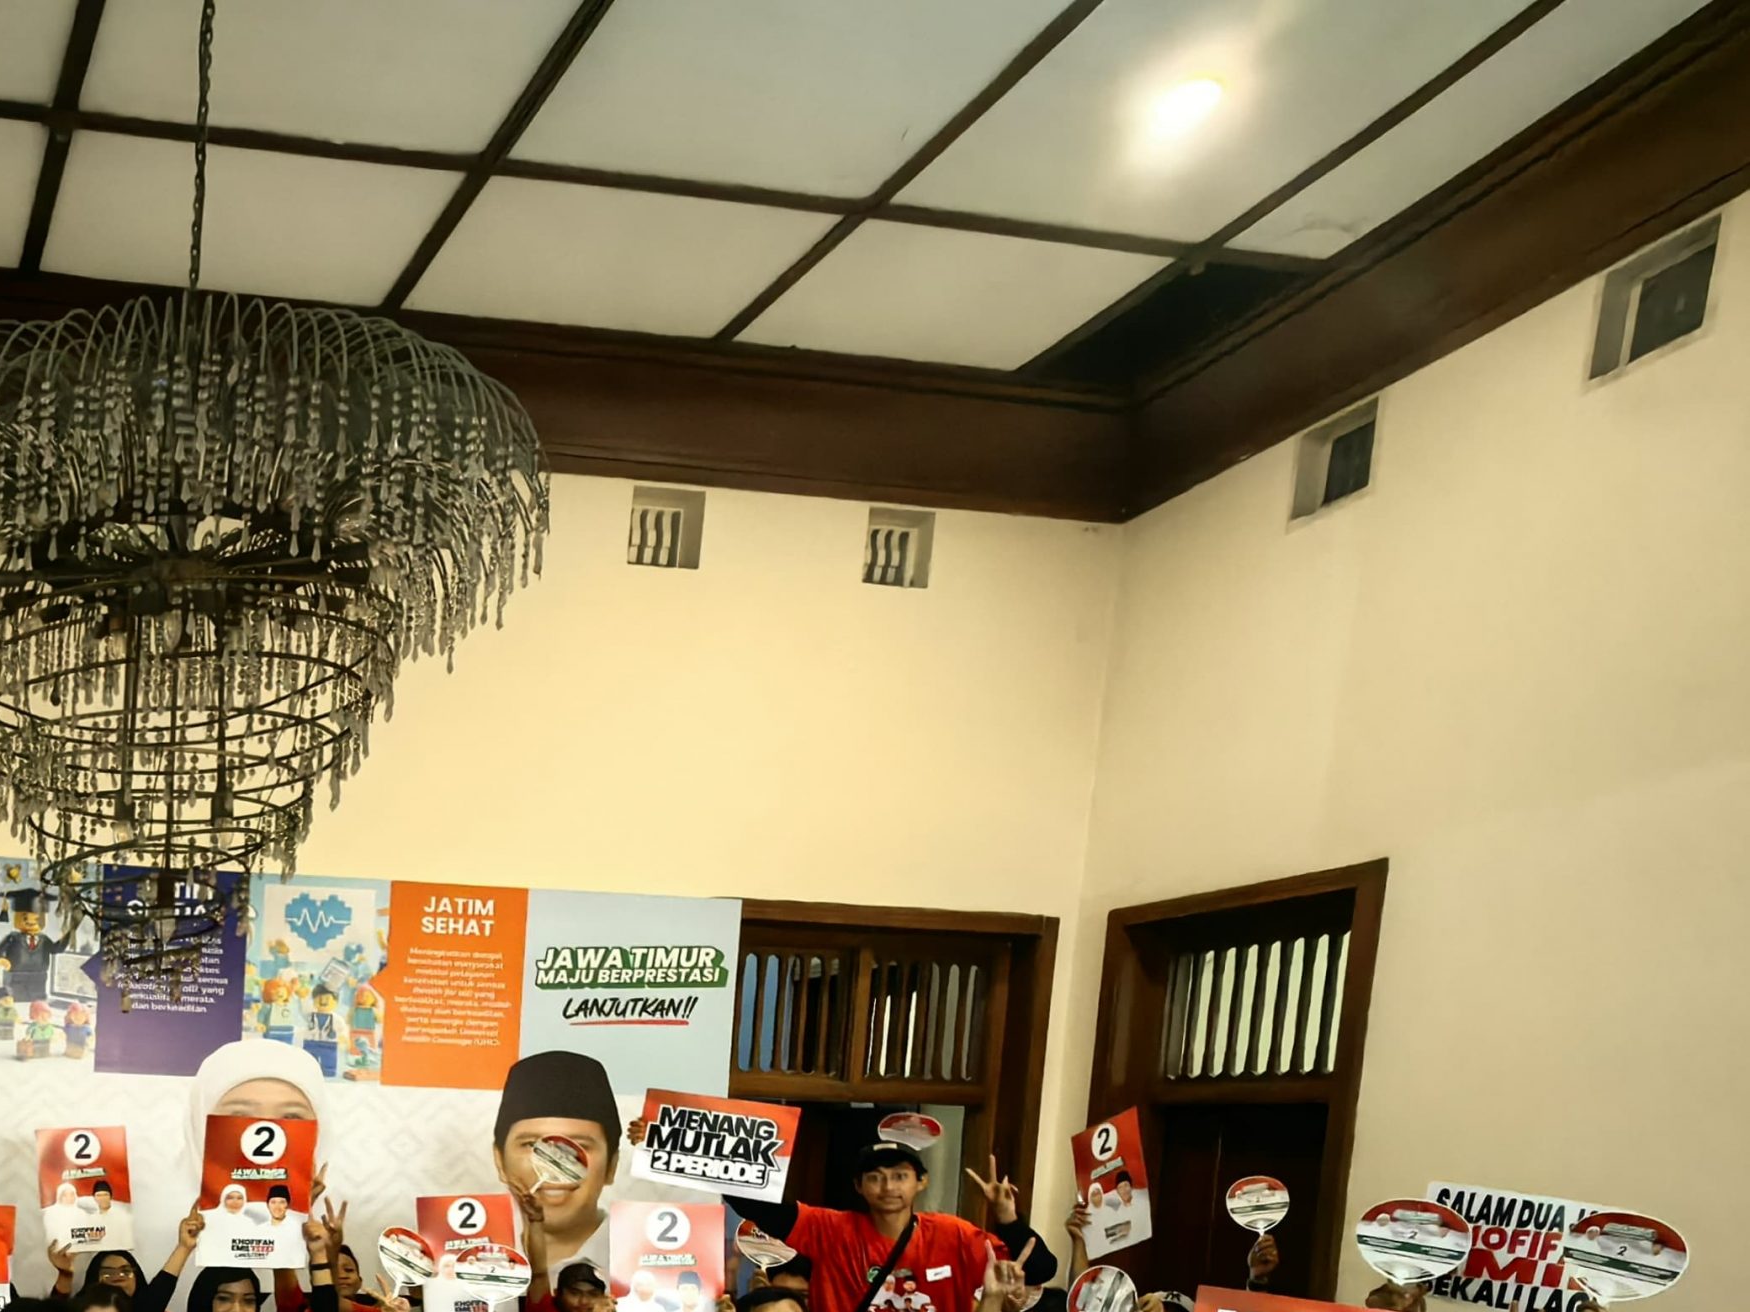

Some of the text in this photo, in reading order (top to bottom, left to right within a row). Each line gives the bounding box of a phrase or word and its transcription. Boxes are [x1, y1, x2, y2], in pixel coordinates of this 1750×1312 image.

[424, 896, 494, 916] JATIM
[421, 916, 494, 937] SEHAT
[536, 947, 716, 969] JAWA TIMUR
[536, 967, 720, 984] MAJU BERPRESTASI
[562, 996, 699, 1020] LANJUTKAN!!
[659, 1107, 775, 1141] MENANG
[73, 1133, 92, 1160] 2
[252, 1126, 275, 1157] 2
[646, 1123, 780, 1168] MUTLAK
[1097, 1127, 1113, 1155] 2
[652, 1151, 766, 1185] 2 PERIODE
[458, 1201, 478, 1229] 2
[656, 1211, 678, 1243] 2
[1516, 1199, 1566, 1233] DUA
[1616, 1245, 1628, 1256] 2
